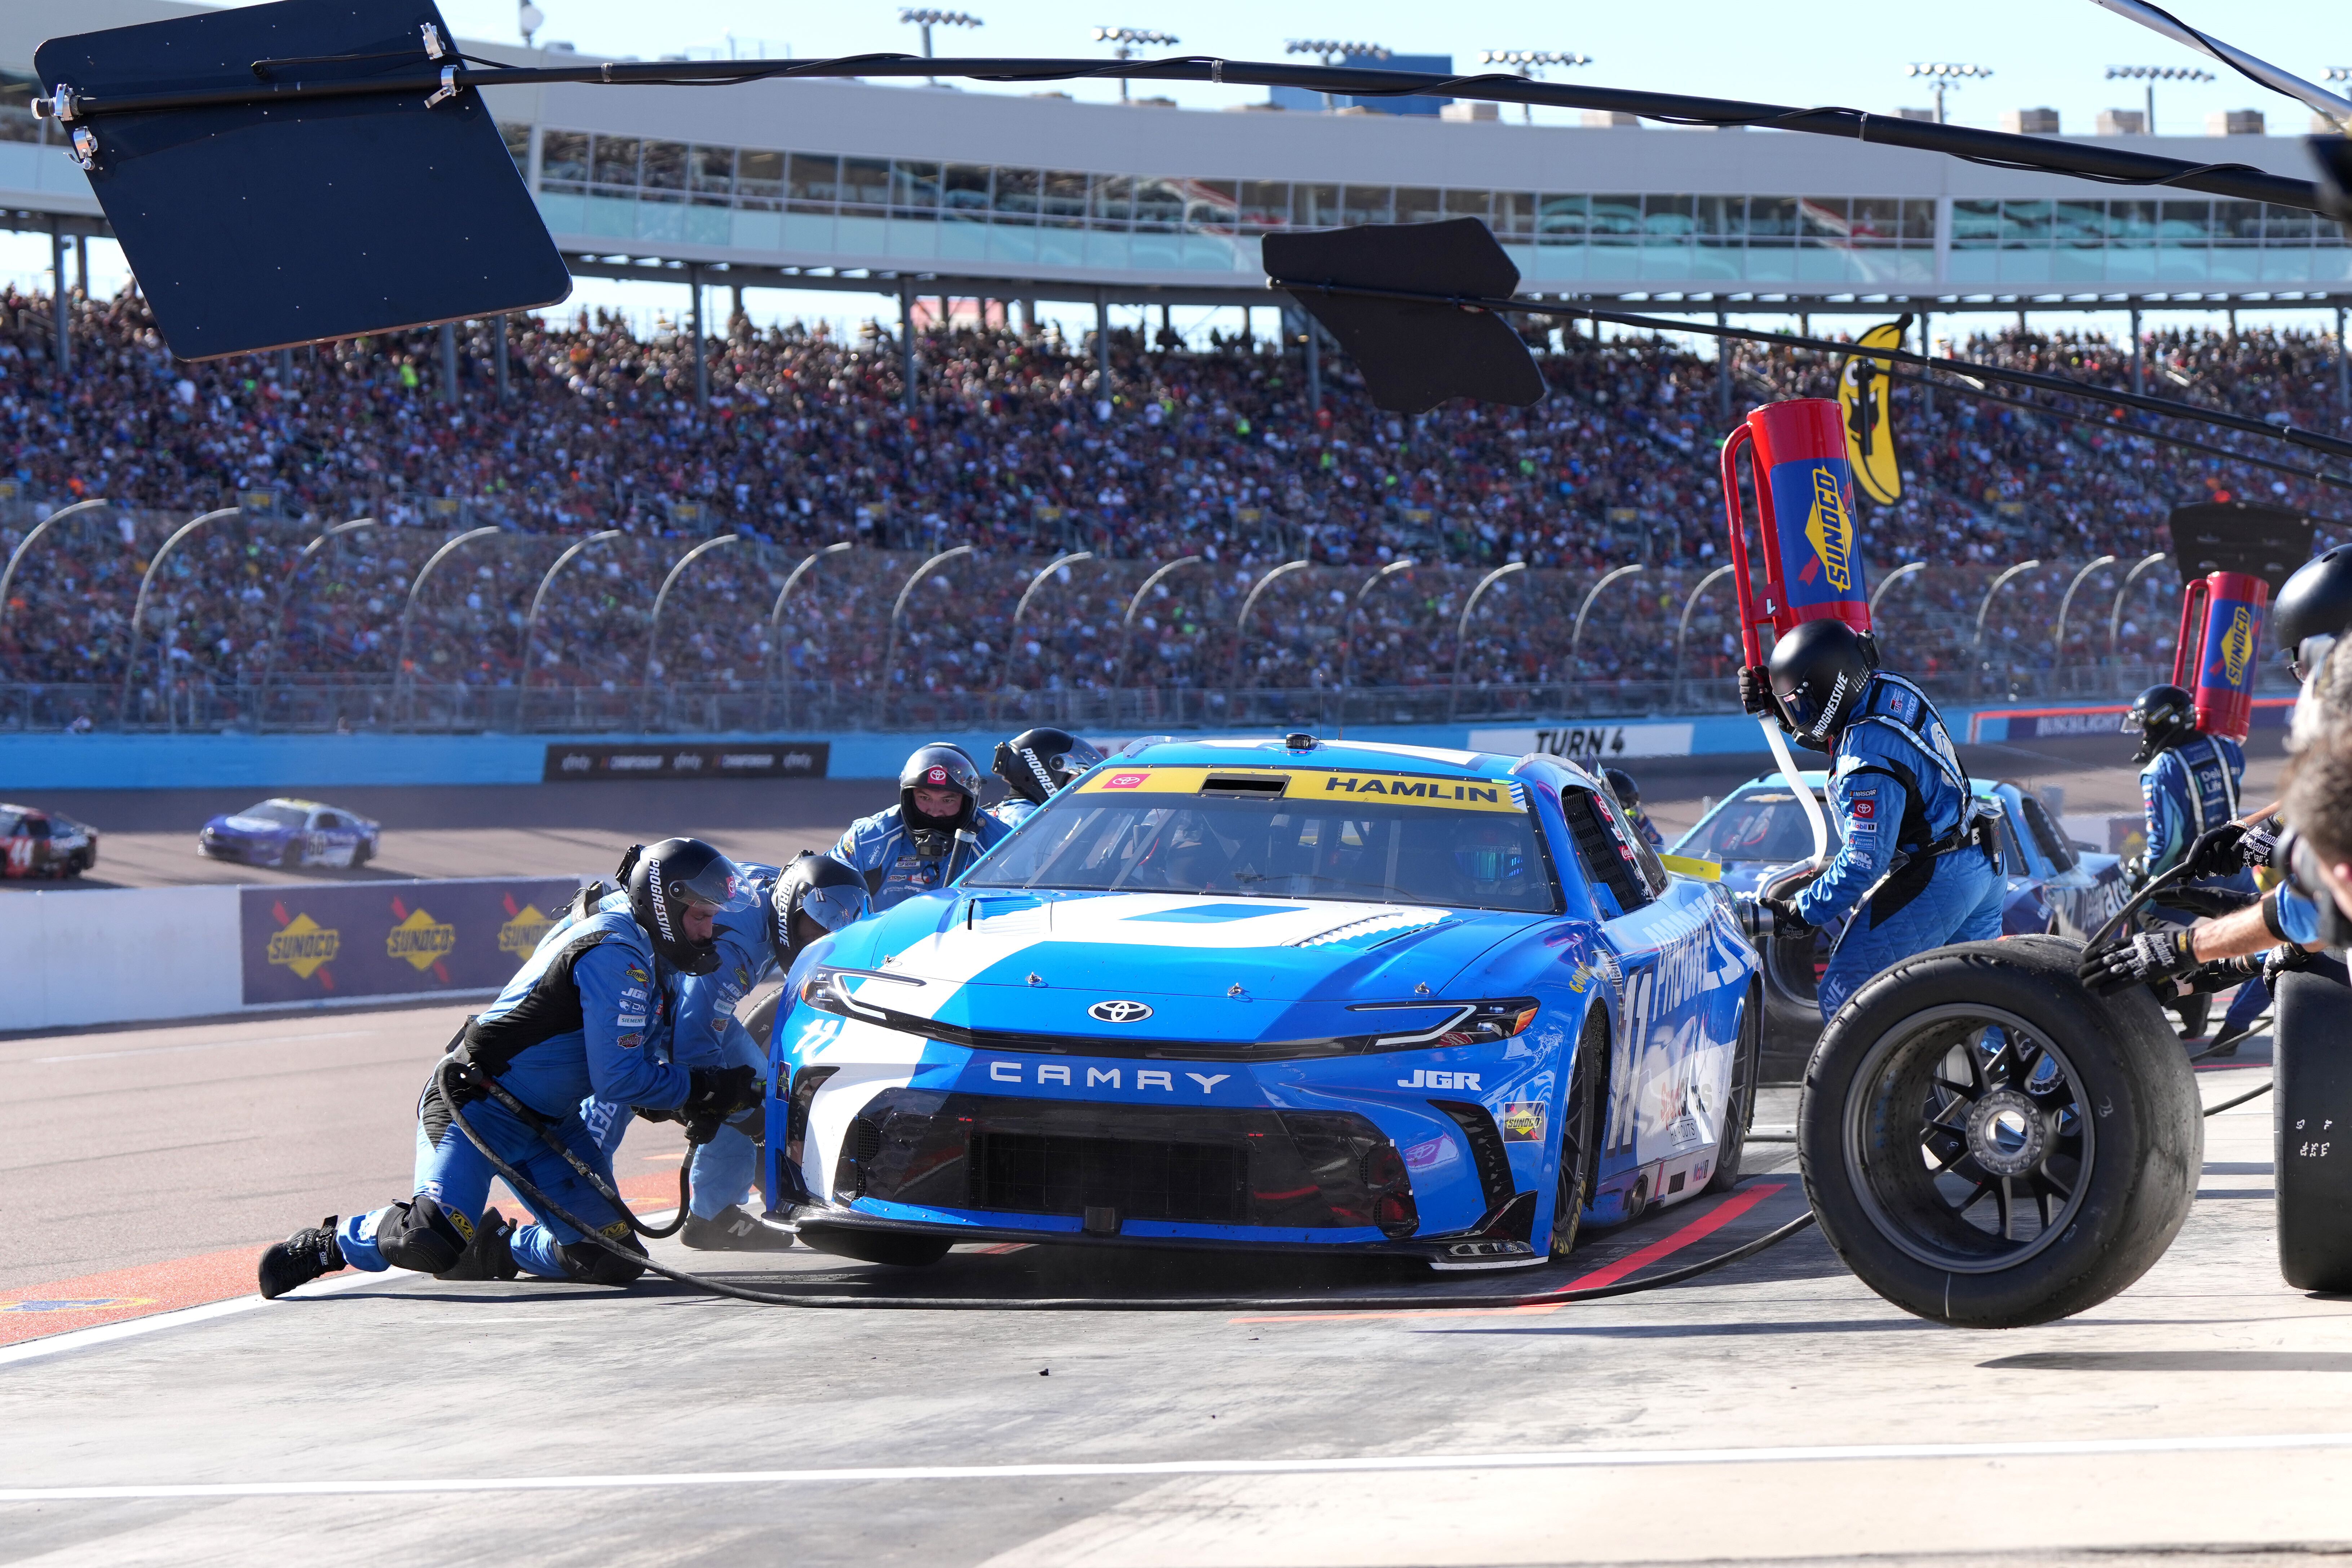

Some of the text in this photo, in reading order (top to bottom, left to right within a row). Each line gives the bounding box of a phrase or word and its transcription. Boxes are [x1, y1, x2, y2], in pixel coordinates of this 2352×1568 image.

[1816, 472, 1849, 586] SUNOCO
[2228, 609, 2248, 681] SUNOCO
[1535, 727, 1625, 757] TURN 4
[1325, 777, 1498, 803] HAMLIN
[10, 839, 34, 865] 44
[868, 845, 880, 865] IMPACT
[649, 858, 676, 942] PROGRESSIVE
[390, 926, 452, 953] SUNOCO
[1781, 927, 1804, 936] Mechanix
[272, 931, 338, 959] SUNOCO
[621, 988, 648, 1002] JGR
[632, 1003, 647, 1012] DN
[792, 1019, 840, 1065] 11
[1606, 971, 1653, 1151] 11
[990, 1061, 1231, 1094] CAMRY
[1397, 1069, 1482, 1091] JGR
[1508, 1117, 1540, 1128] SUNOCO
[1670, 1123, 1695, 1143] HAIRCUTS
[498, 1225, 508, 1237] OMP
